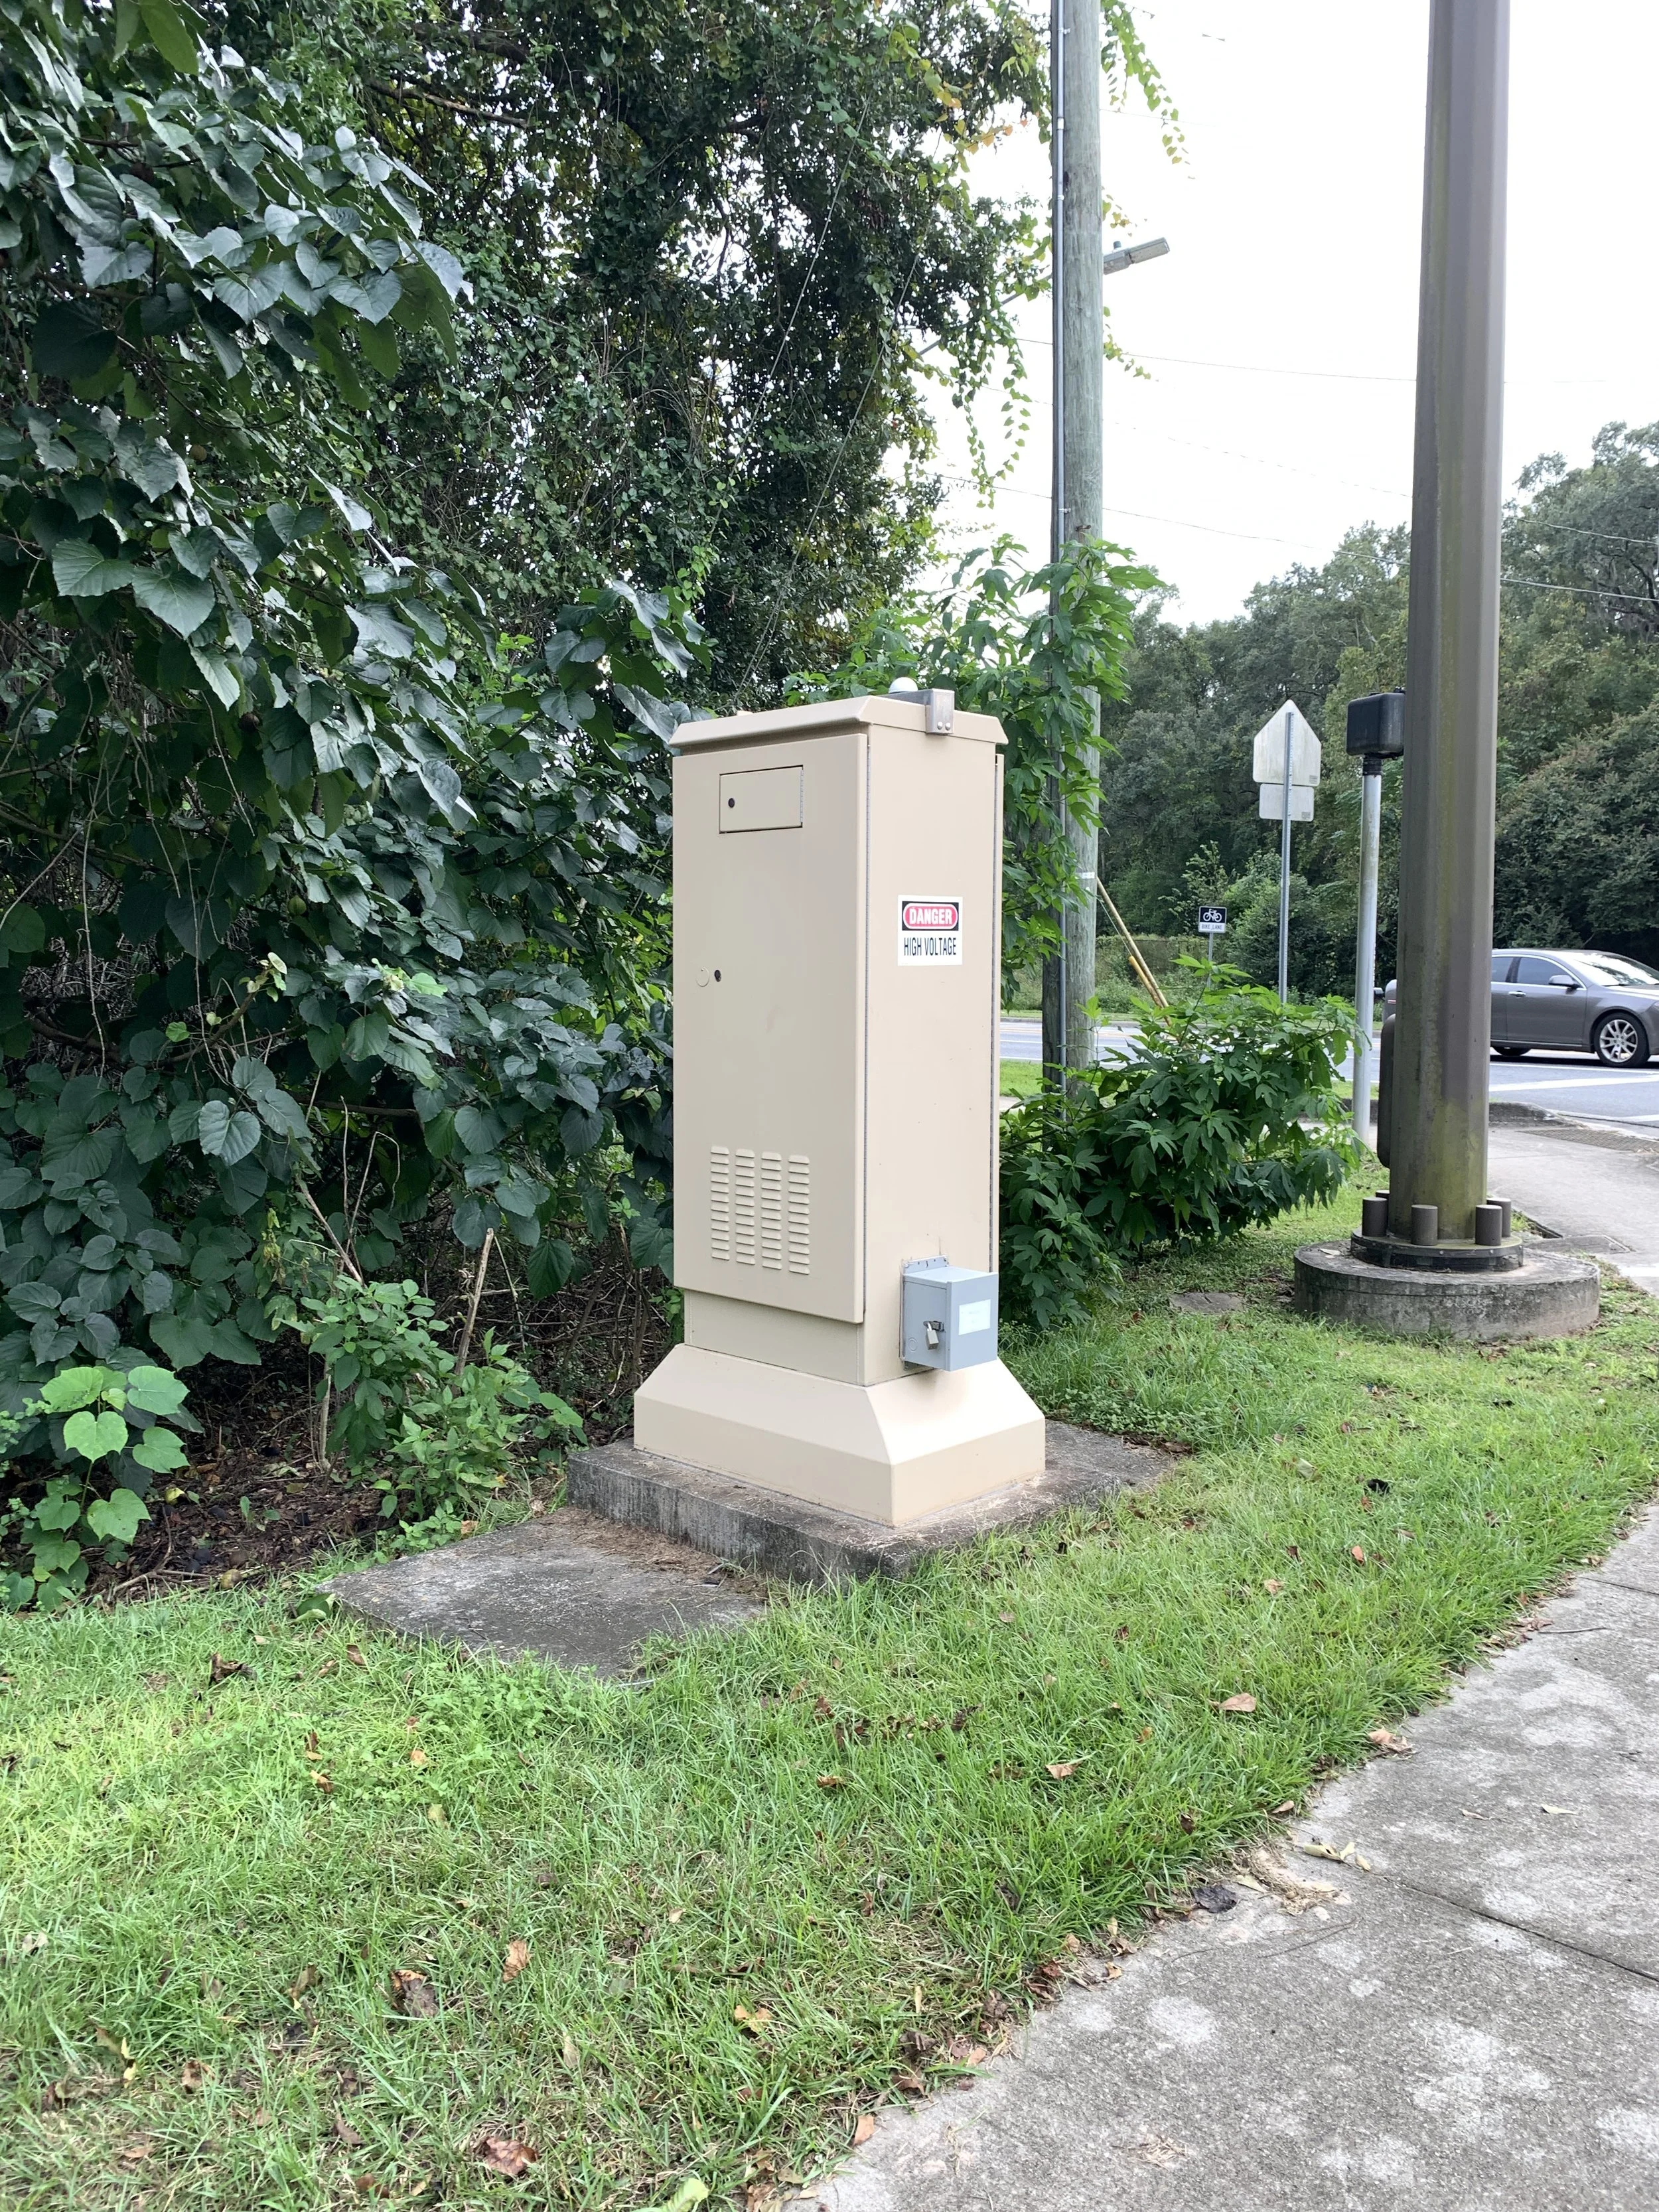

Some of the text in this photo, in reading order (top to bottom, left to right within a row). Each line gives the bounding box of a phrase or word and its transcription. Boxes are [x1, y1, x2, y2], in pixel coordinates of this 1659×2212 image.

[909, 907, 952, 924] DANGER
[904, 937, 956, 956] HIGH VOLTAGE
